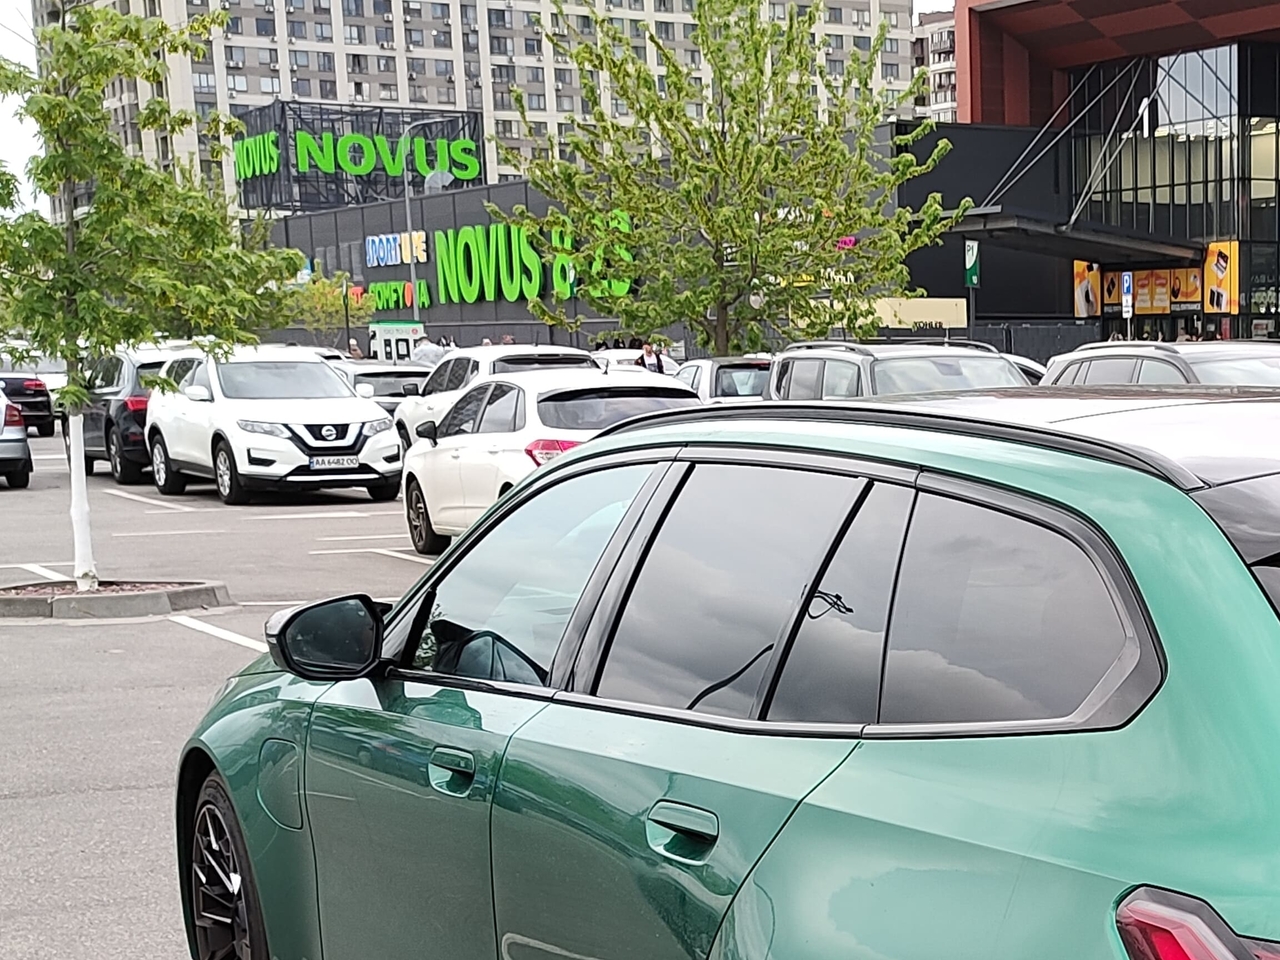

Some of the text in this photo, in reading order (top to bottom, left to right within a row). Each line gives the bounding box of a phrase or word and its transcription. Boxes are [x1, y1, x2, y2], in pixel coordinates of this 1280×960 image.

[234, 130, 281, 181] NOVUS
[296, 130, 481, 180] NOVUS
[434, 222, 543, 304] NOVUS
